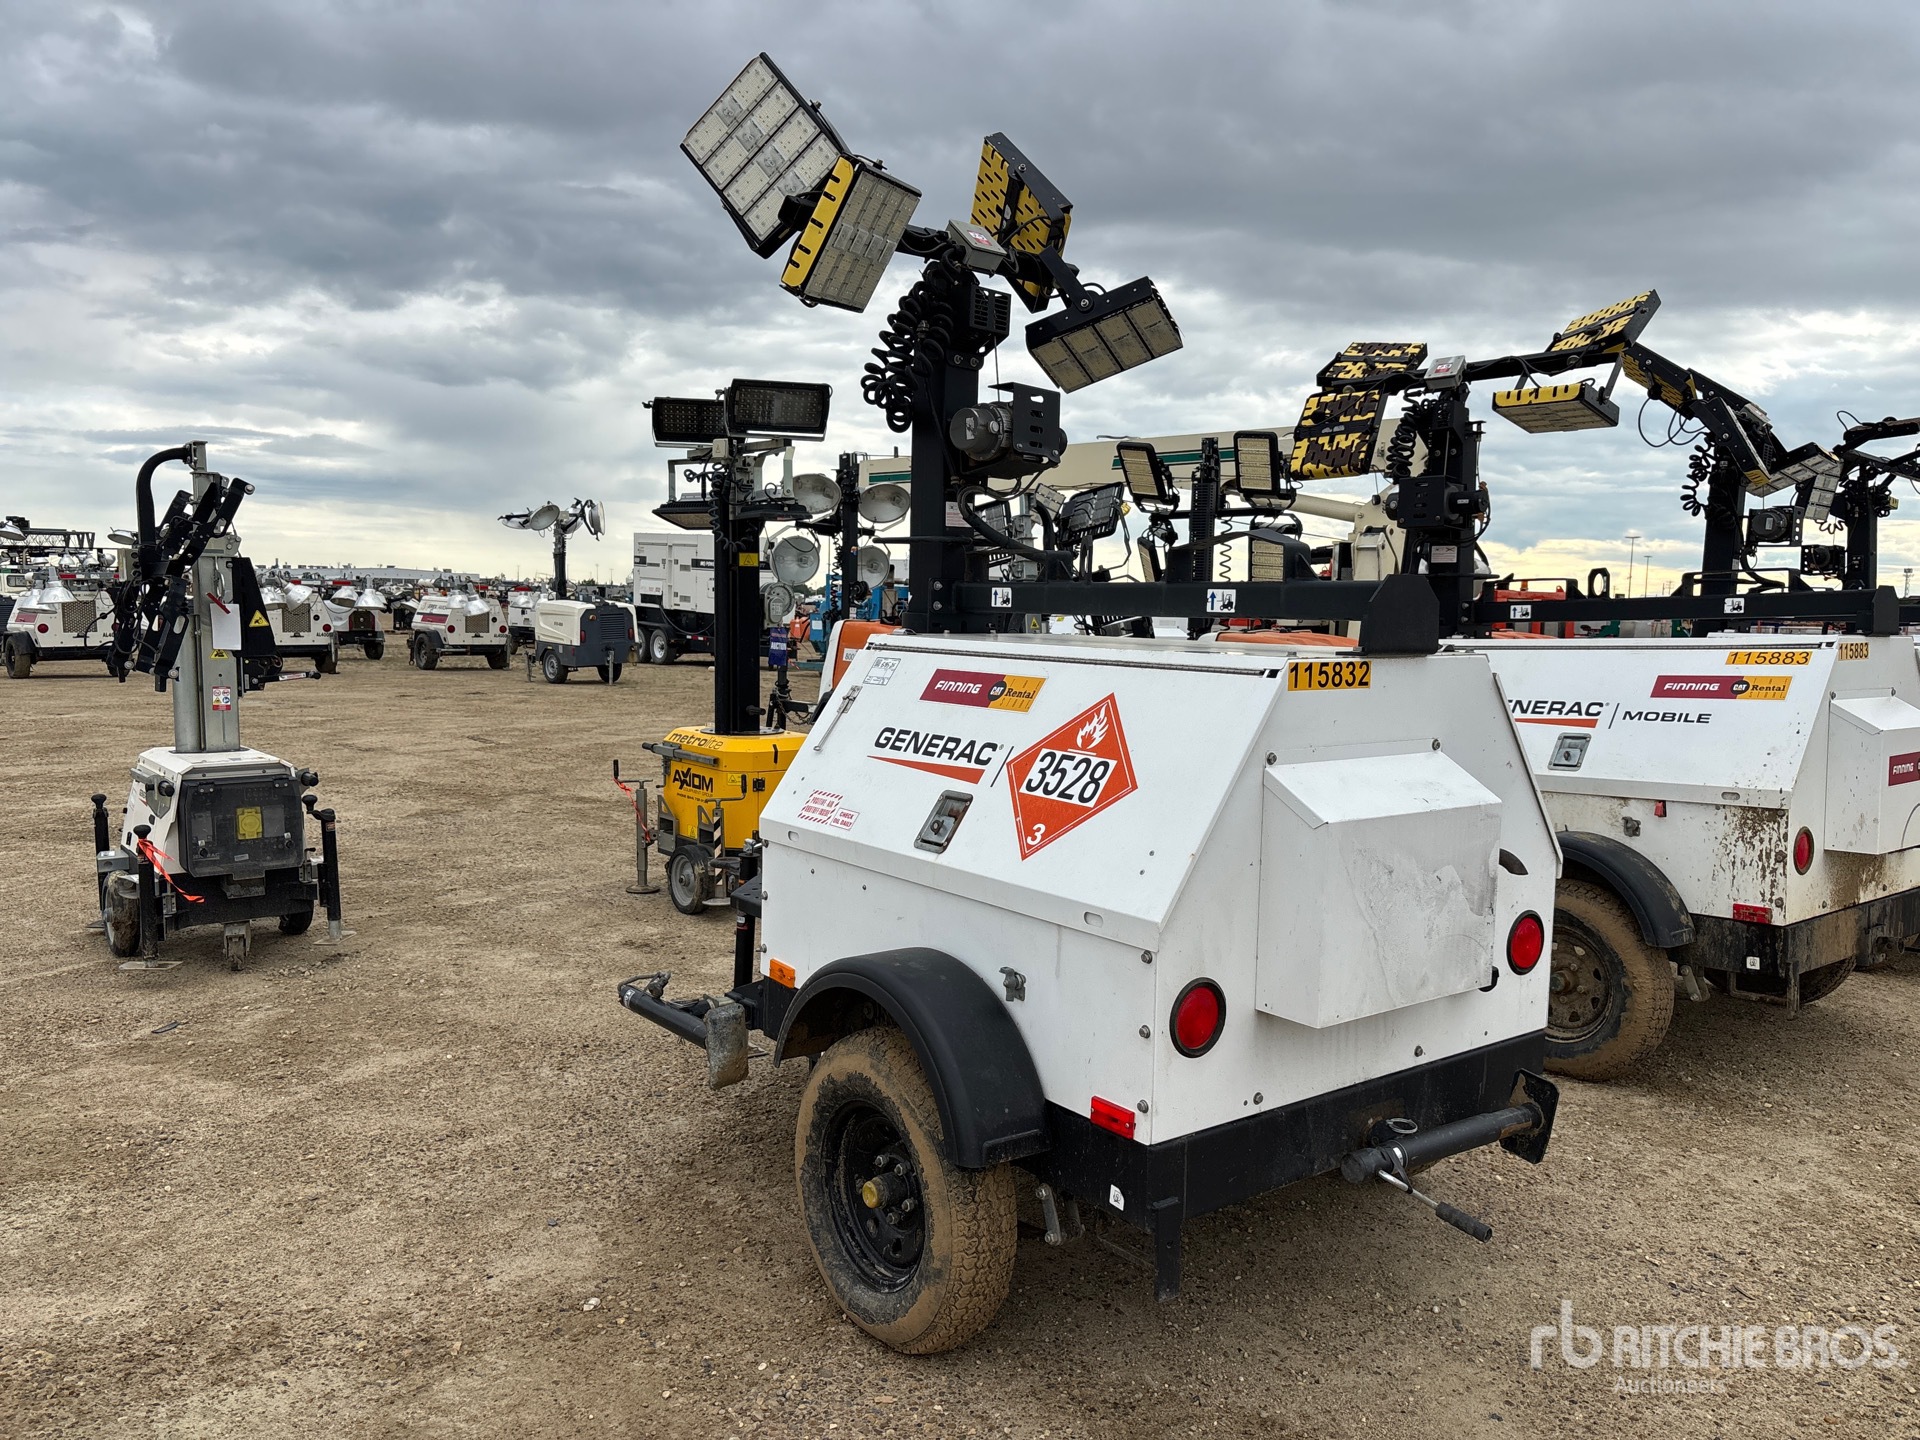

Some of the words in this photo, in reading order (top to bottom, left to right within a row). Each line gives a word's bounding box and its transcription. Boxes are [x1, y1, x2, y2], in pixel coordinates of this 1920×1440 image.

[1729, 651, 1810, 665] 115883
[1838, 642, 1870, 660] 115883
[1289, 660, 1370, 689] 115832
[934, 680, 983, 694] FINNING
[990, 686, 1004, 696] CAT
[1004, 687, 1036, 699] Rental
[1663, 682, 1721, 691] FINNING
[1732, 683, 1748, 691] CAT
[1751, 683, 1786, 692] Rental
[1508, 699, 1604, 717] NERAC
[1621, 710, 1712, 724] MOBILE
[668, 732, 724, 750] metrolite
[874, 726, 998, 766] GENERAC
[672, 767, 714, 793] AXIOM
[1024, 751, 1110, 804] 3528
[1026, 823, 1046, 846] 3
